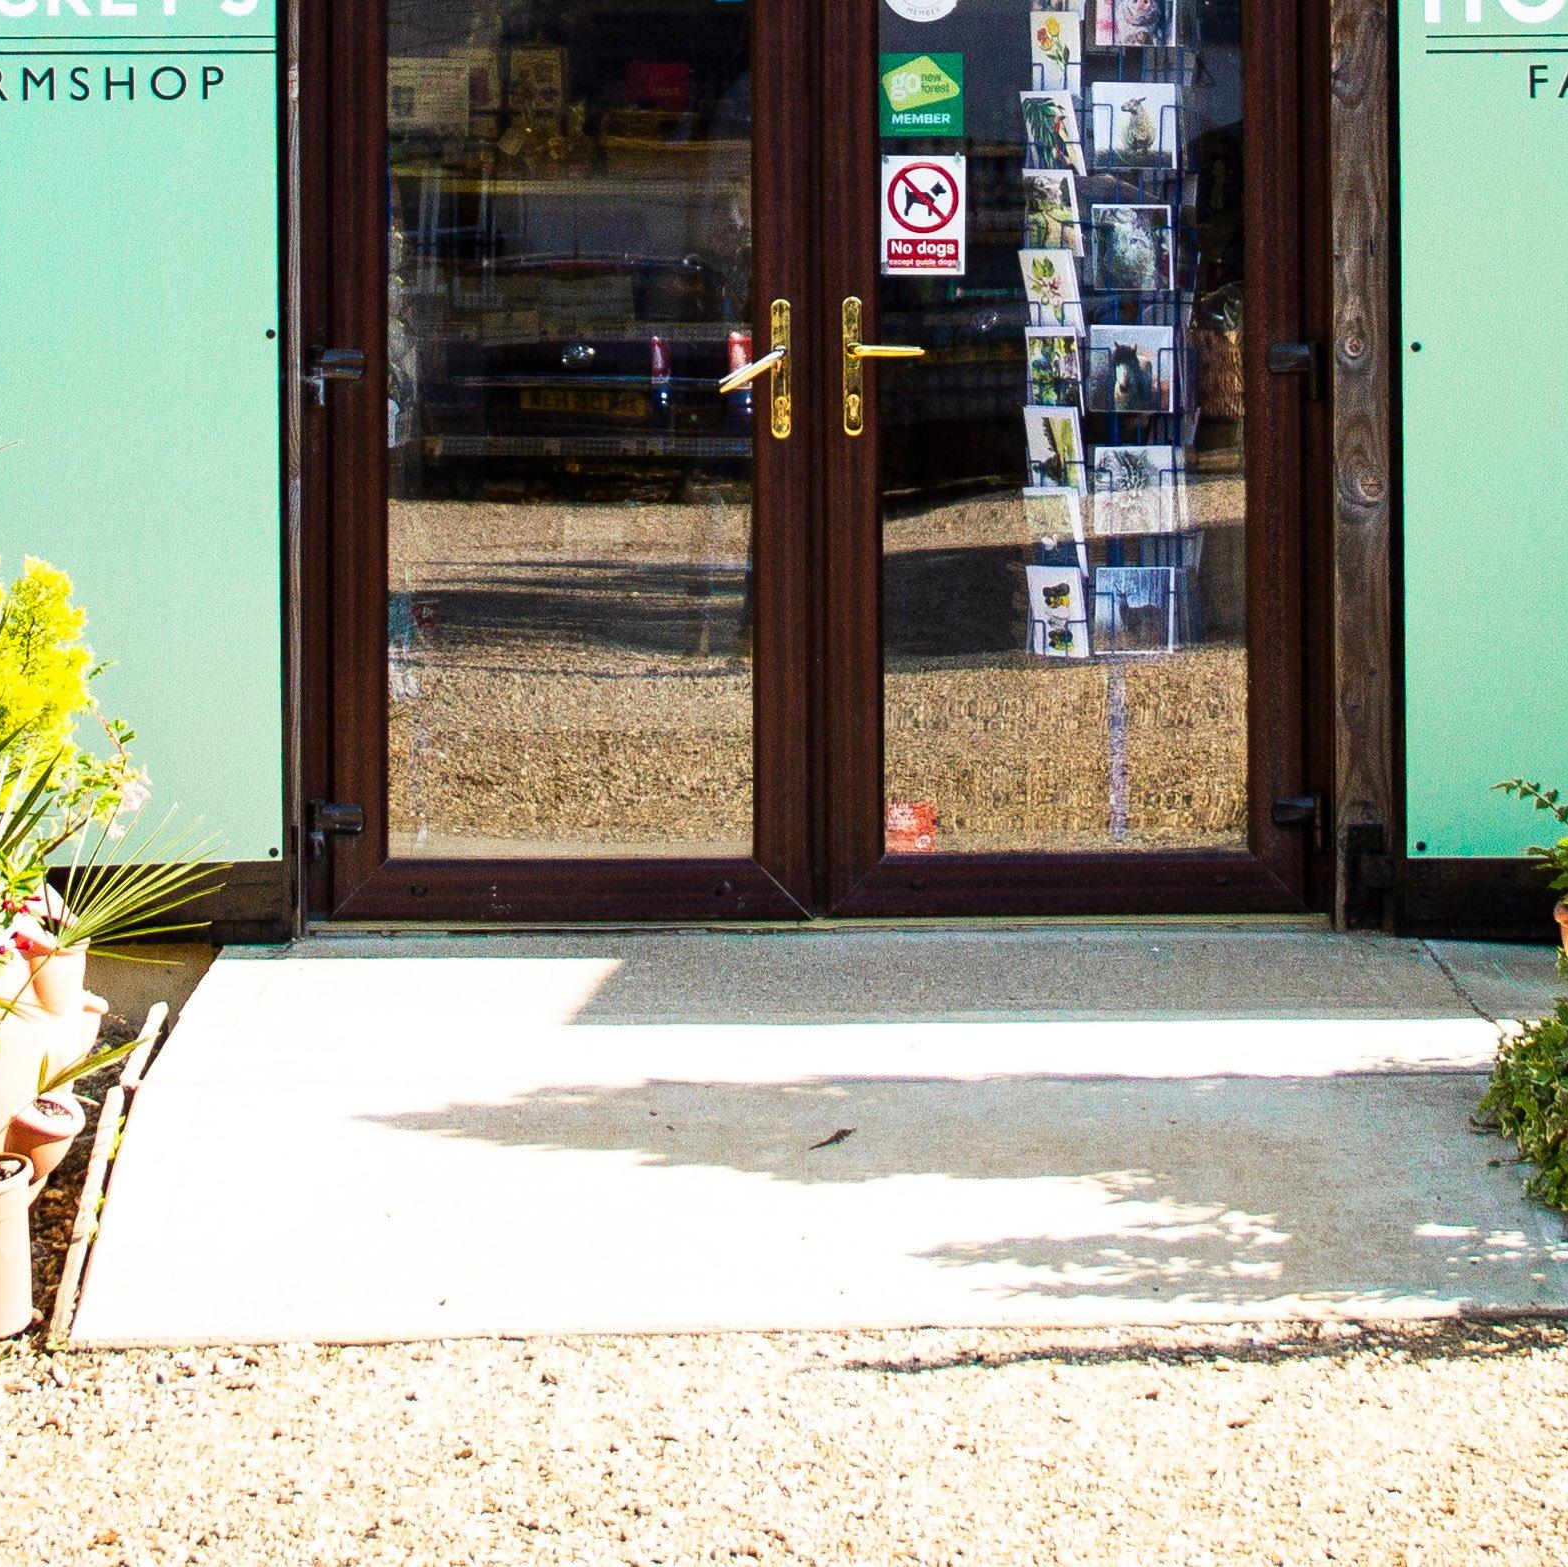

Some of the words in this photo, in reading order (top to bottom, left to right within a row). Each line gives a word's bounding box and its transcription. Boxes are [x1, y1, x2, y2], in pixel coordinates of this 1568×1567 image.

[891, 73, 922, 102] go
[891, 113, 951, 125] MEMBER
[890, 240, 913, 255] No
[916, 240, 956, 258] dogs
